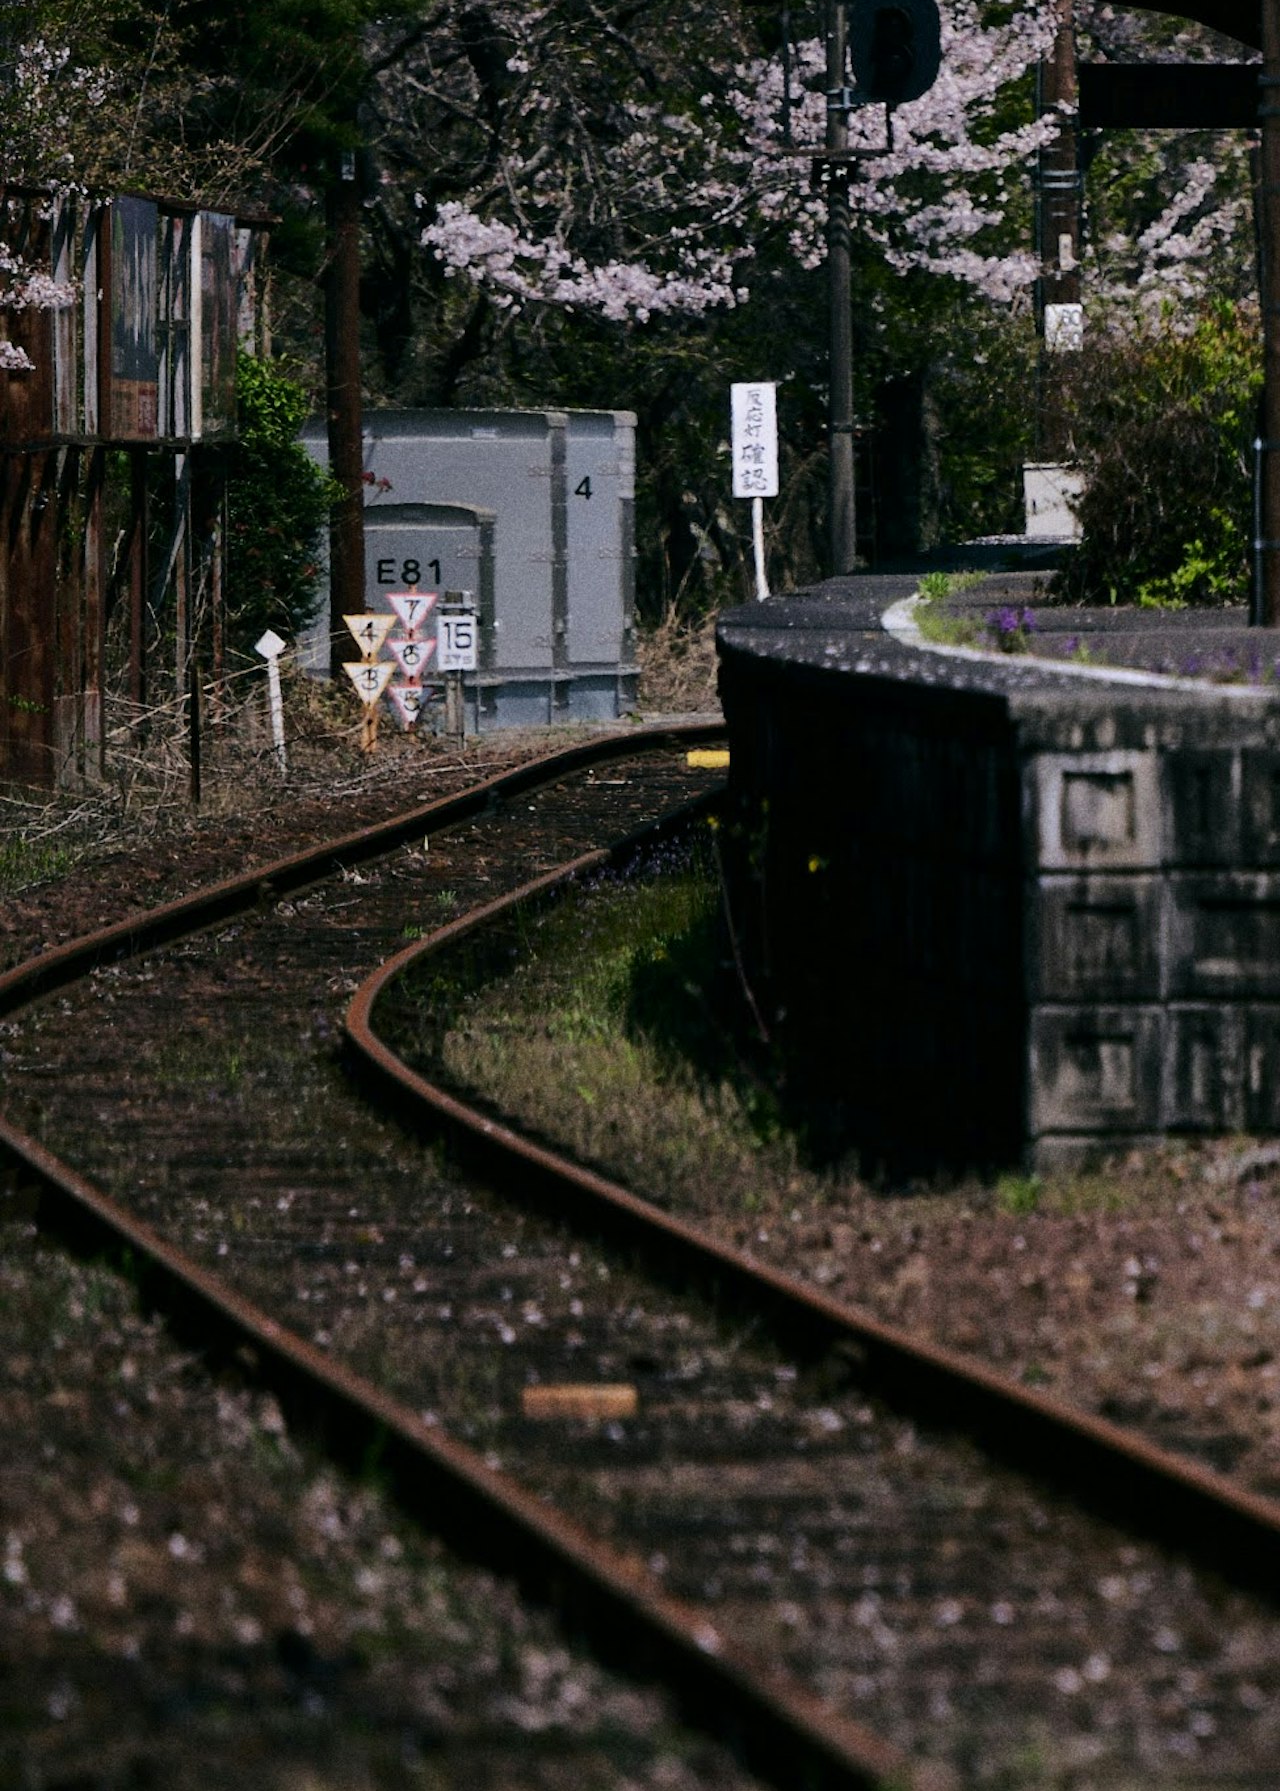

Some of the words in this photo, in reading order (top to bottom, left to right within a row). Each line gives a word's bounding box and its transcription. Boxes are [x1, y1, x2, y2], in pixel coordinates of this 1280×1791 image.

[742, 389, 767, 491] 反応灯確認
[575, 476, 593, 500] 4
[377, 559, 442, 585] E81
[405, 599, 421, 619] 7
[360, 621, 378, 642] 4
[444, 622, 472, 649] 15
[403, 644, 421, 665] 6
[362, 670, 378, 690] 3
